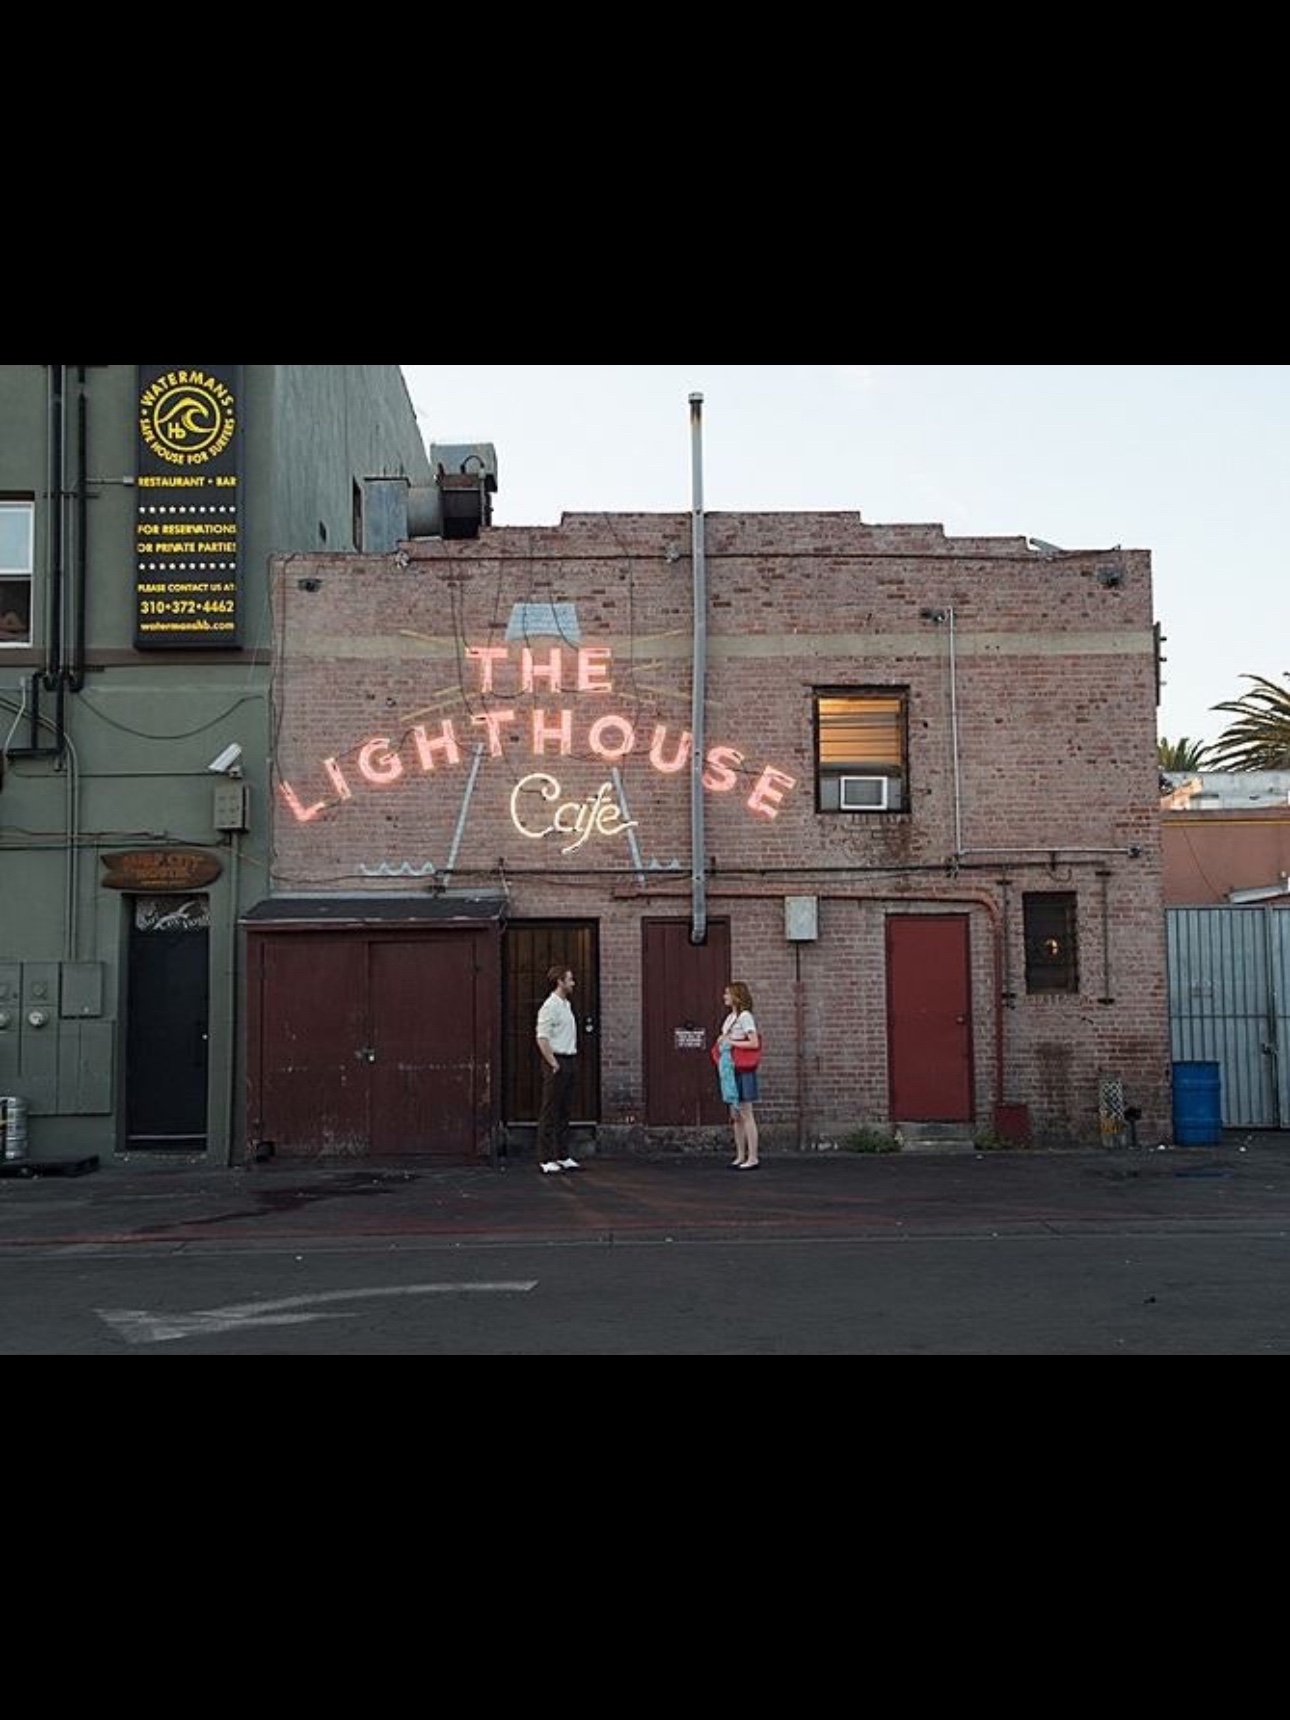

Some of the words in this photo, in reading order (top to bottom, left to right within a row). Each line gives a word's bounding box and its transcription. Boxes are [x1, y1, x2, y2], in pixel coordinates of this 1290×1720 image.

[140, 370, 235, 406] WATERMANS
[150, 441, 184, 465] HOUSE
[187, 450, 209, 465] FOR
[138, 475, 205, 487] RESTAURANT
[216, 475, 236, 487] BAR
[137, 524, 159, 534] FOR
[162, 524, 236, 534] RESERVATIONS
[156, 543, 195, 553] PRIVATE
[138, 584, 166, 592] PLEASE
[168, 584, 208, 592] CONTACT
[465, 647, 613, 693] THE
[279, 708, 797, 822] LIGHTHOUSE
[510, 773, 639, 854] Cafe
